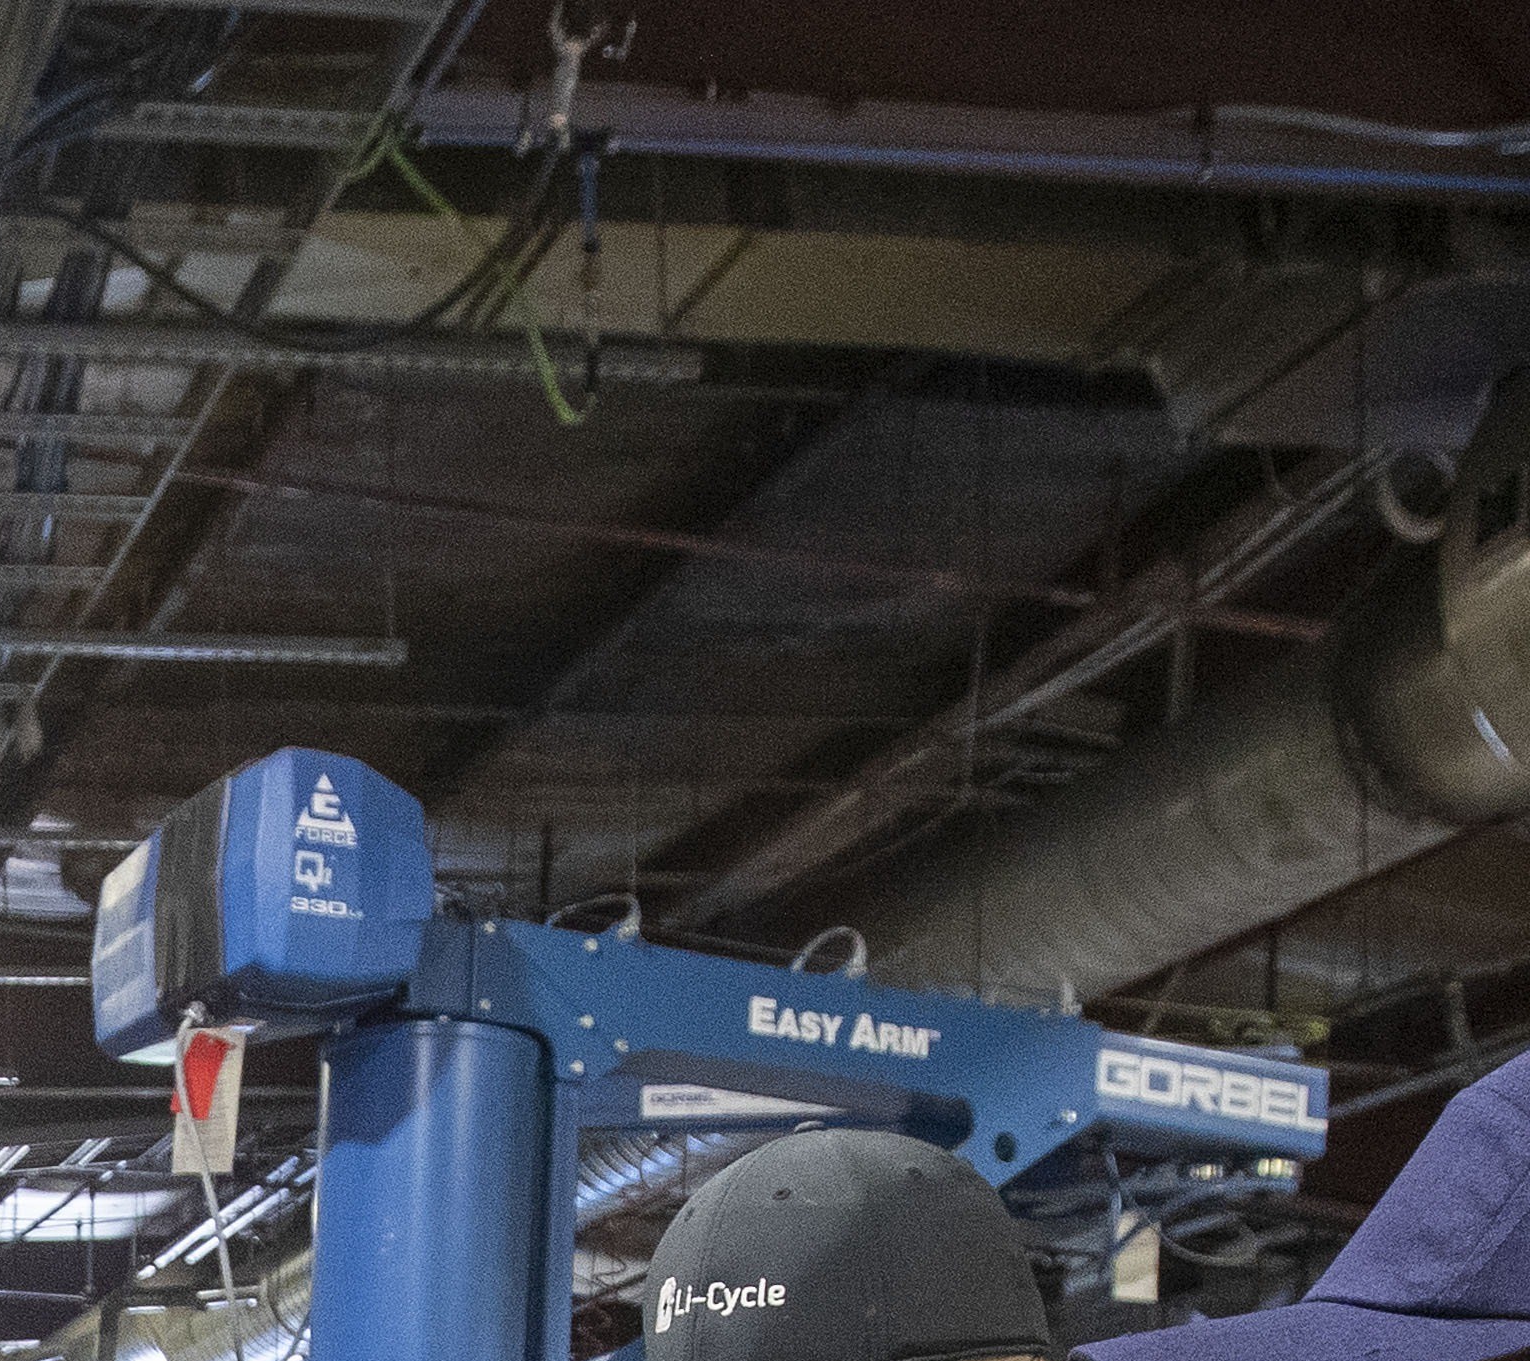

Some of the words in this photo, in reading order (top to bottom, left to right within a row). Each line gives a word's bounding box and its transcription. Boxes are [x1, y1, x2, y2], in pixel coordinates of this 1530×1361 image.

[294, 825, 357, 849] FORCE
[291, 896, 348, 917] 330
[1096, 1048, 1328, 1136] GORBEL
[673, 1276, 787, 1317] Li-Cycle
